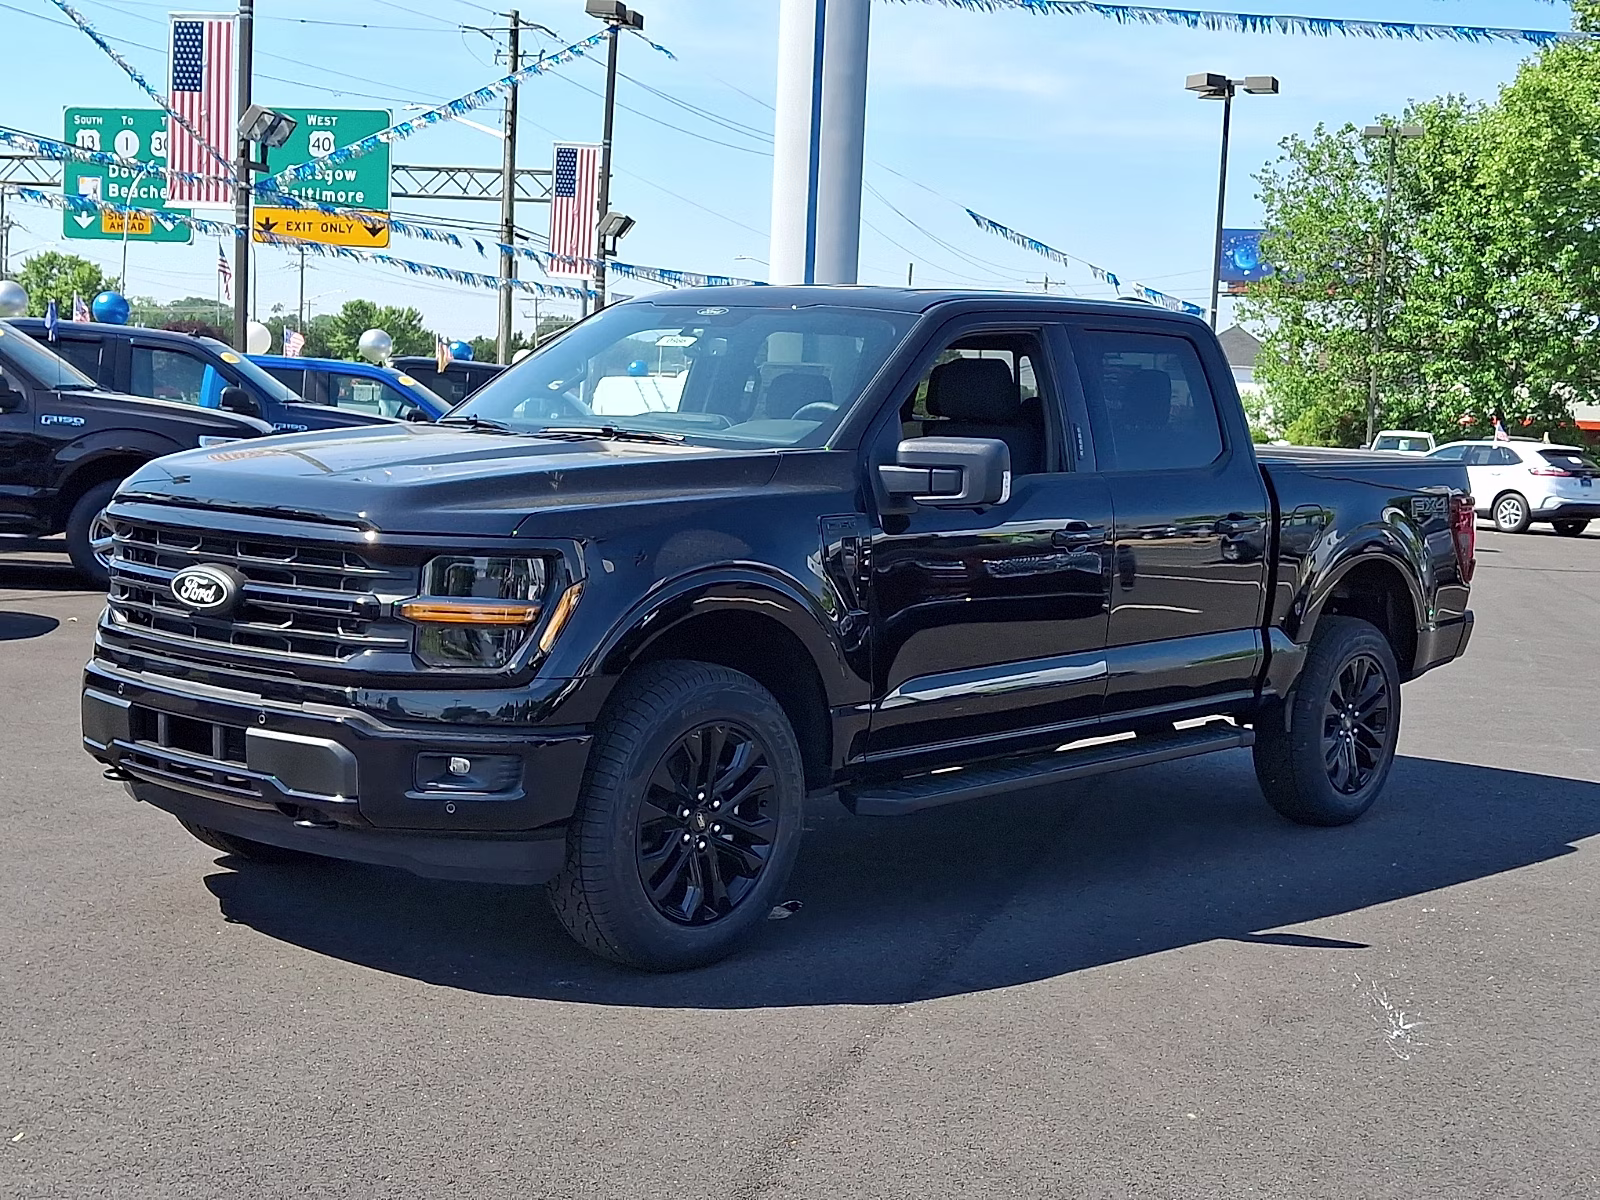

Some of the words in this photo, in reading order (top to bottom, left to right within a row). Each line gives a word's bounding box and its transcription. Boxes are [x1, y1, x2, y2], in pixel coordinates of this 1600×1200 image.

[161, 117, 167, 125] T
[307, 115, 338, 127] WEST
[81, 135, 95, 150] 13
[125, 137, 129, 149] 1
[312, 137, 332, 152] 40
[108, 183, 167, 199] Beache
[109, 220, 145, 231] AHAD
[286, 221, 313, 232] EXIT
[320, 222, 354, 233] ONLY
[1411, 497, 1448, 518] FX4
[180, 575, 217, 603] Ford
